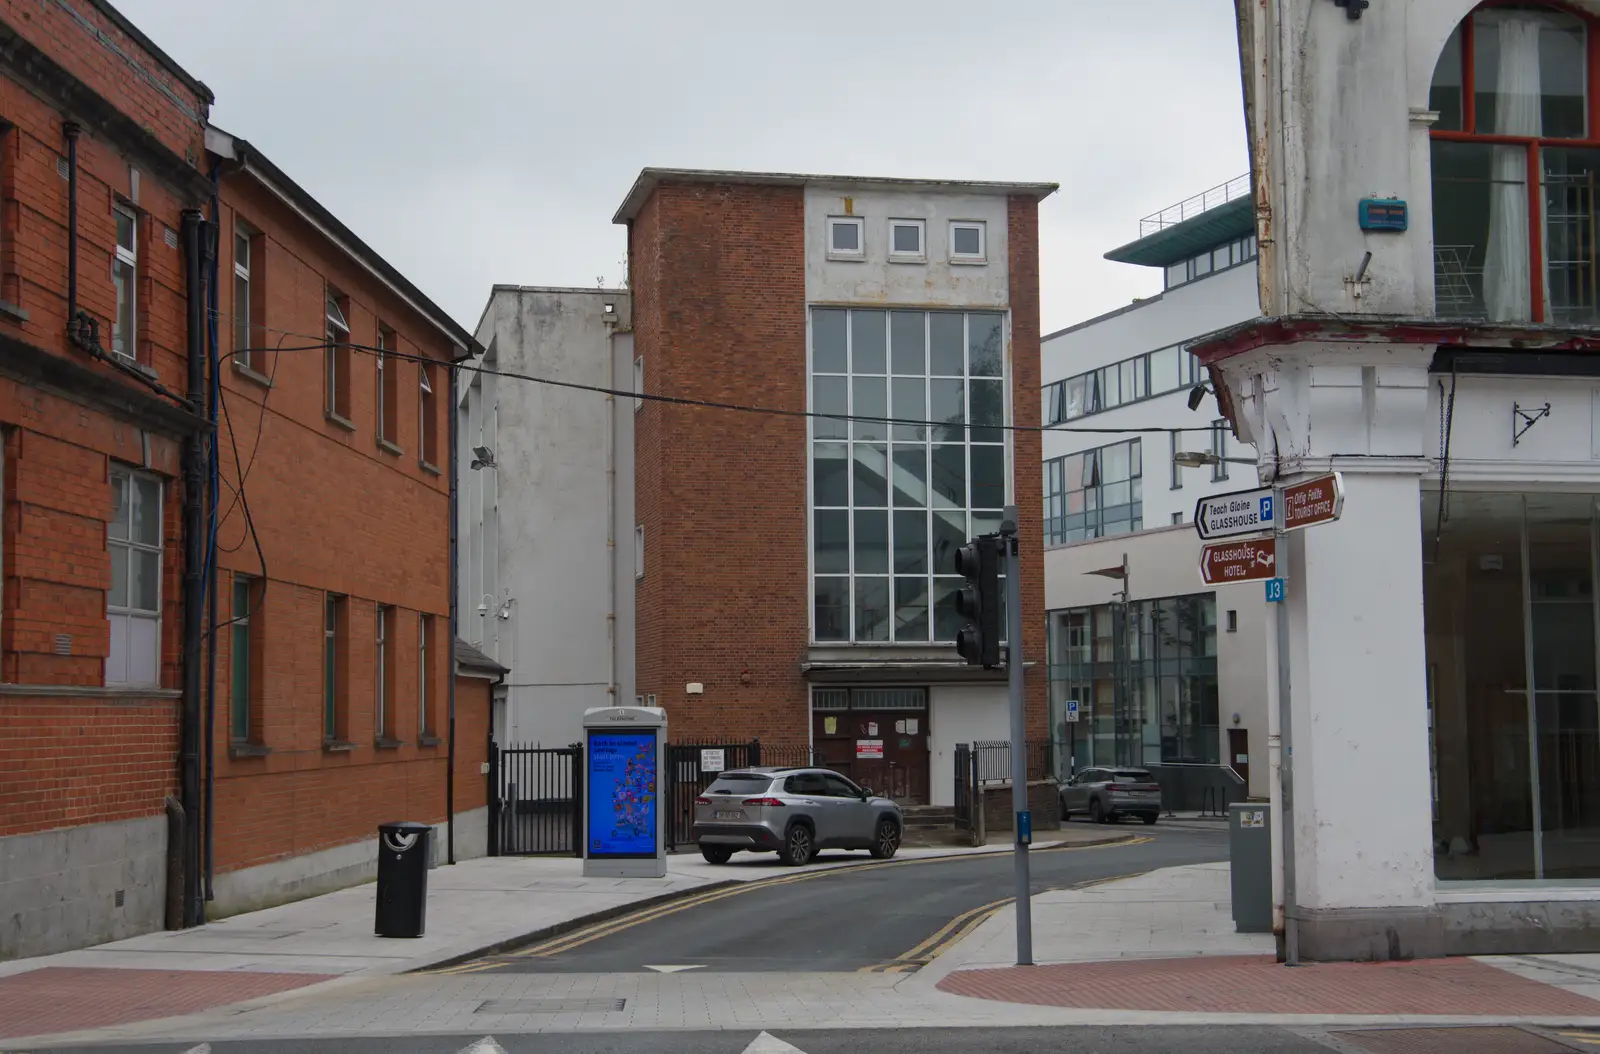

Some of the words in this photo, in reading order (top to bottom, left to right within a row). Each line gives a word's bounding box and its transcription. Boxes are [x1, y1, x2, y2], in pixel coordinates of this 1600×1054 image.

[1210, 504, 1227, 515] Teach
[1230, 500, 1251, 512] Gloine
[1295, 504, 1313, 519] TOURIST
[1314, 500, 1331, 515] OFFICE
[1211, 513, 1258, 530] GLASSHOUSE
[1213, 547, 1255, 562] GLASSHOUSE
[1224, 565, 1243, 577] HOTEL
[1269, 582, 1281, 599] J3
